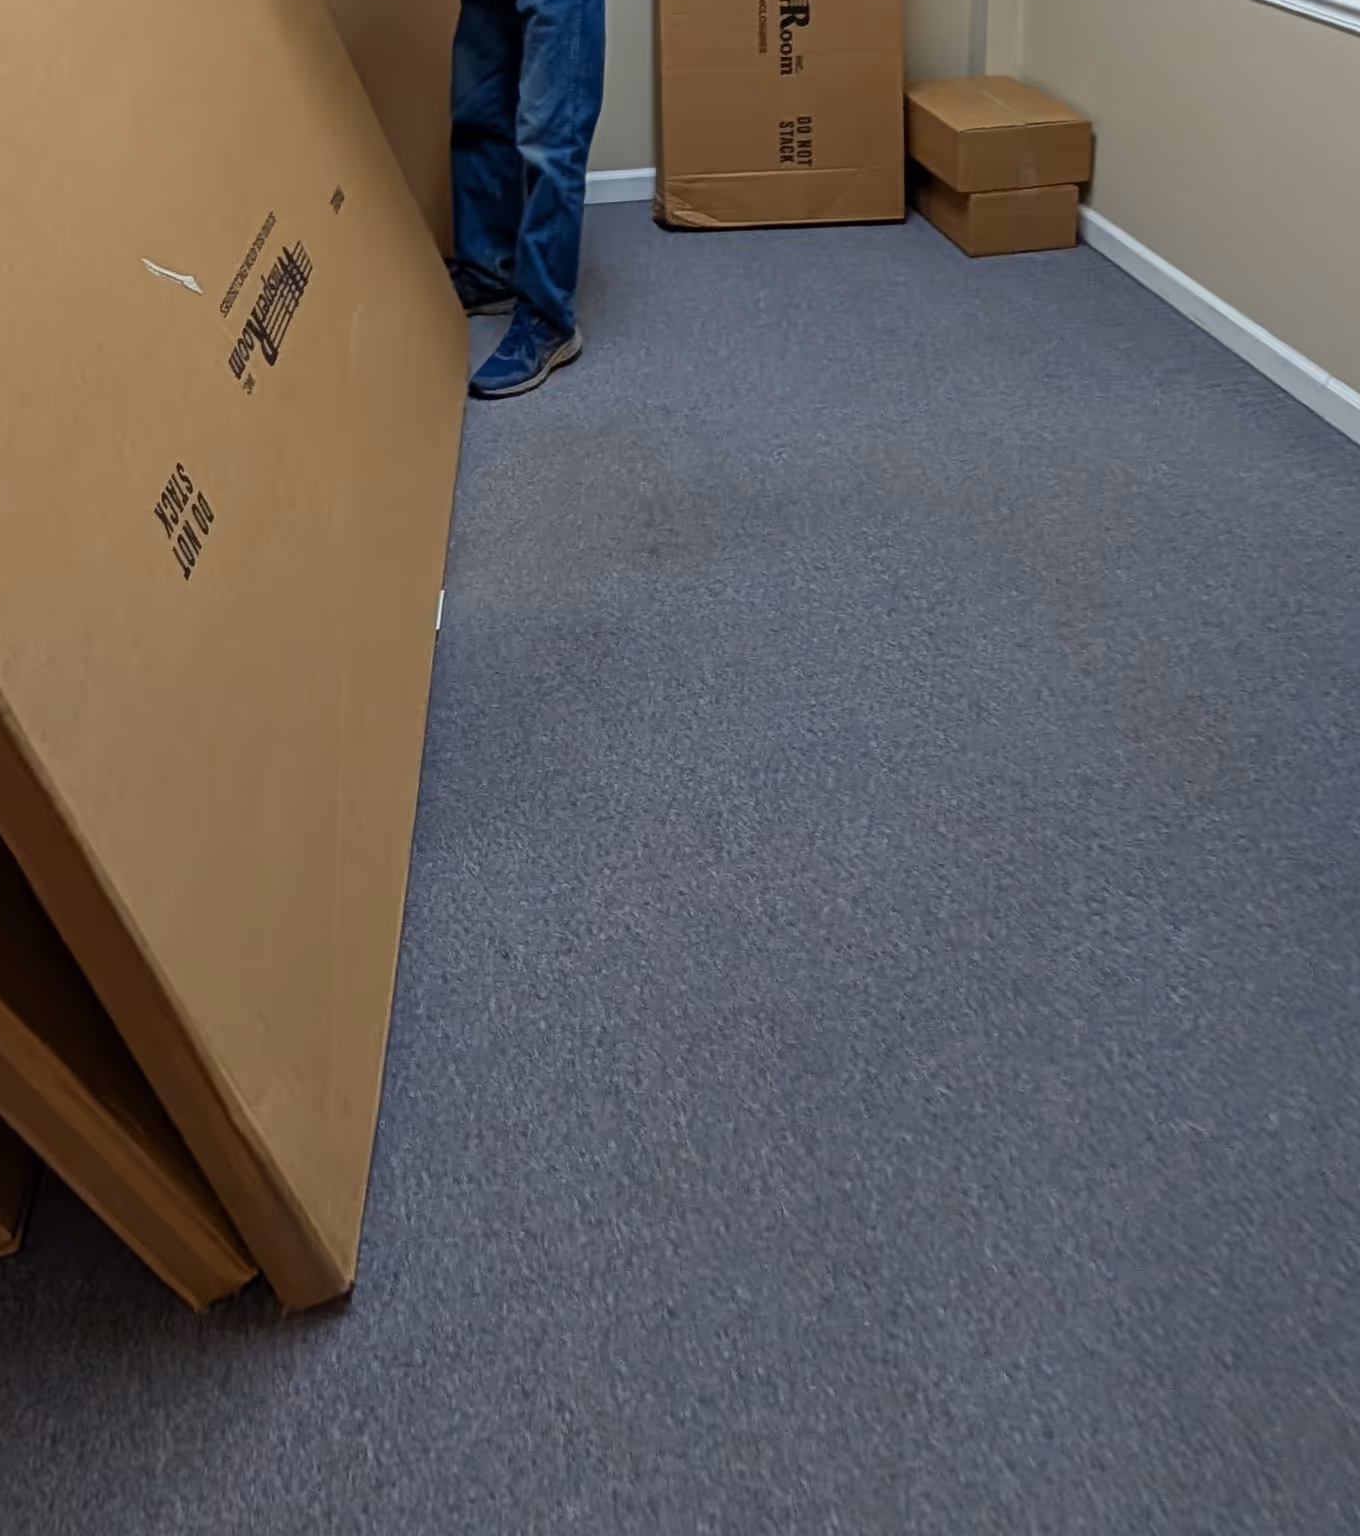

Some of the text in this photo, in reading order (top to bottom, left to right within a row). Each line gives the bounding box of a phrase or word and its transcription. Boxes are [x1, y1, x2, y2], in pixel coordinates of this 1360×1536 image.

[779, 121, 795, 163] STACK
[796, 116, 813, 167] DO NOT
[153, 462, 194, 539] STACK
[172, 489, 215, 581] DO NOT
